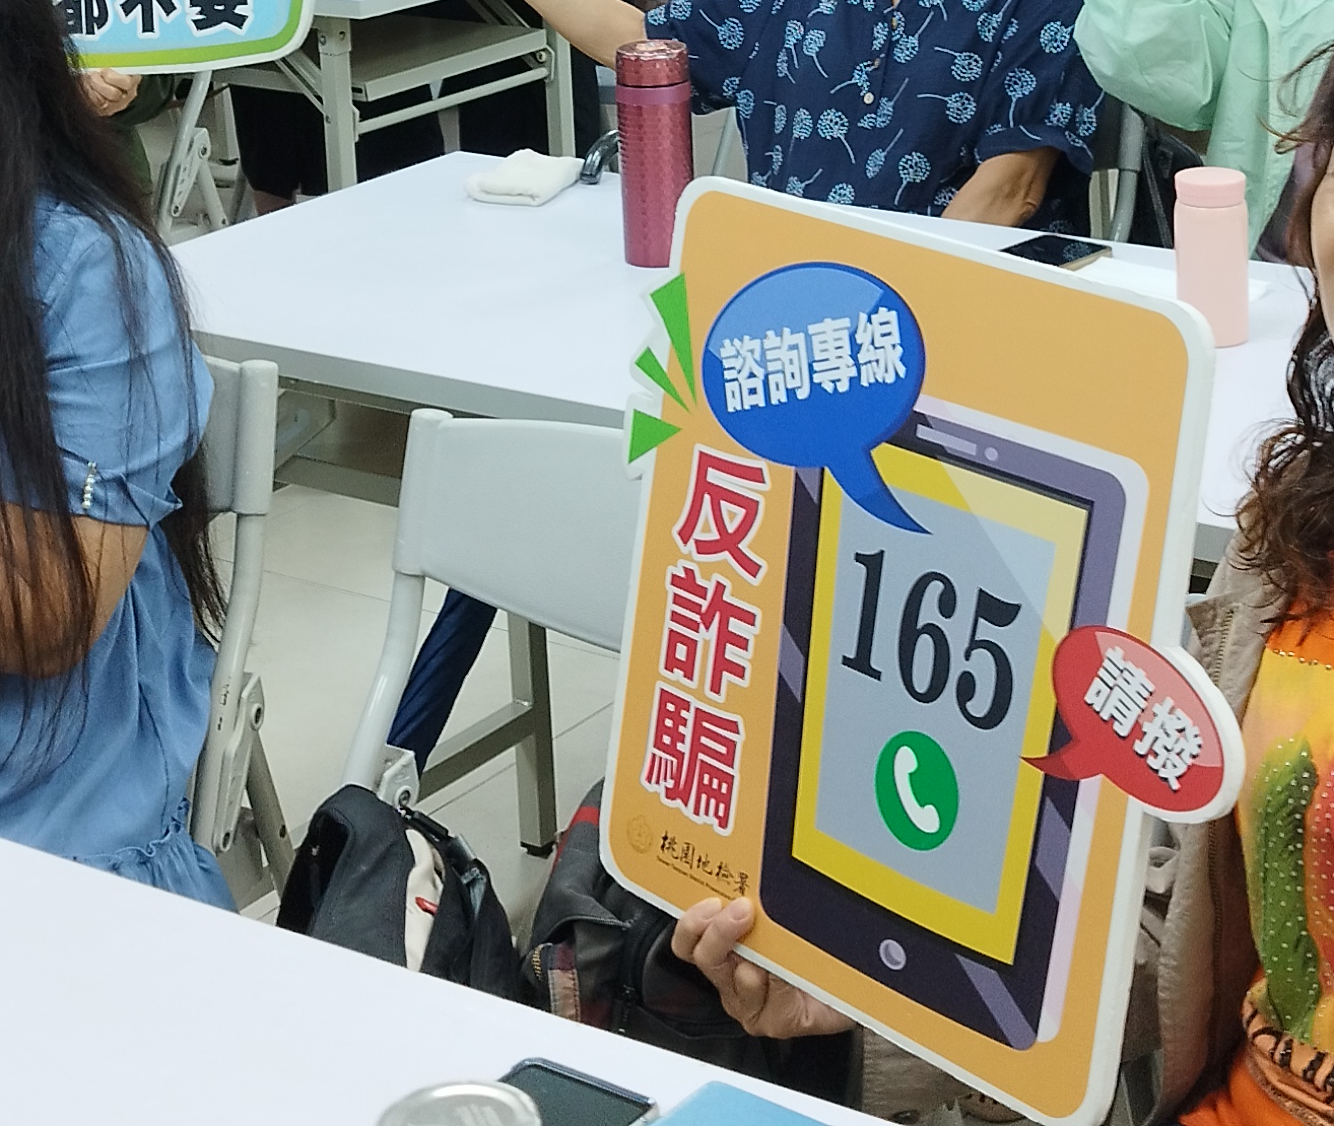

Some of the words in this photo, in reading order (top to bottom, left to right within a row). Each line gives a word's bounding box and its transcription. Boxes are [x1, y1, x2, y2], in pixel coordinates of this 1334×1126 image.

[720, 306, 907, 413] 諮詢專線
[646, 449, 770, 829] 反詐騙
[840, 549, 1023, 731] 165
[1083, 645, 1202, 792] 請撥
[659, 830, 750, 896] 桃園地檢署
